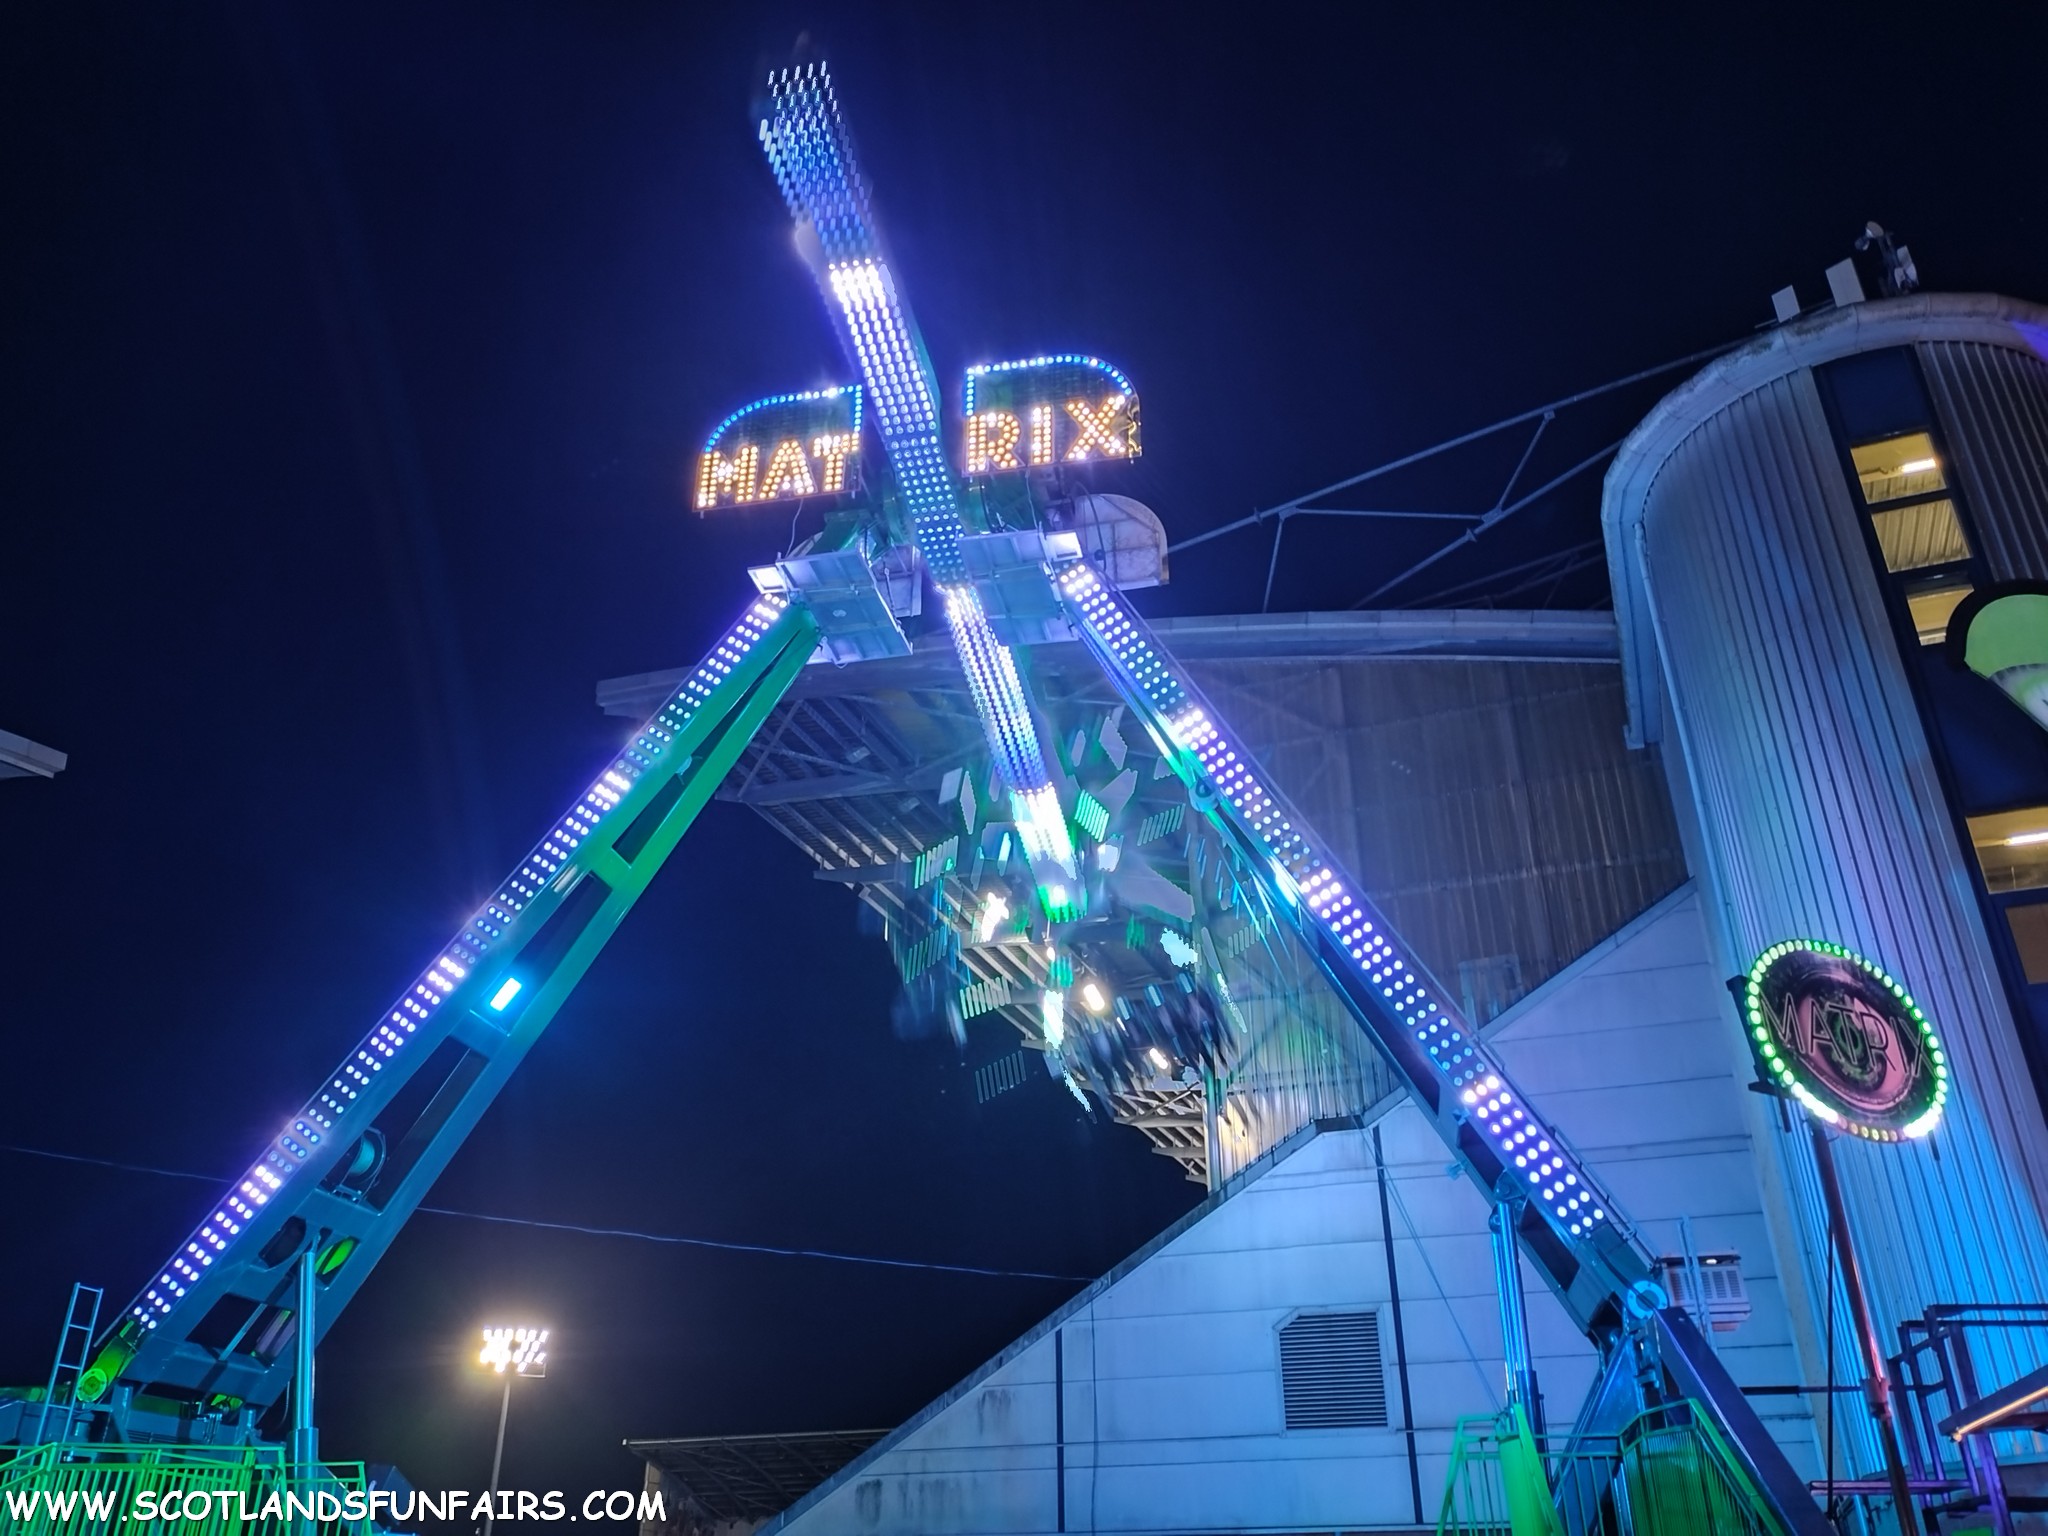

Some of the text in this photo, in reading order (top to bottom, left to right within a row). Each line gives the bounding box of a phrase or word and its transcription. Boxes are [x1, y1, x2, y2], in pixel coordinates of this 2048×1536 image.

[694, 394, 1130, 508] MAT RIX
[1759, 991, 1938, 1080] MATRIX
